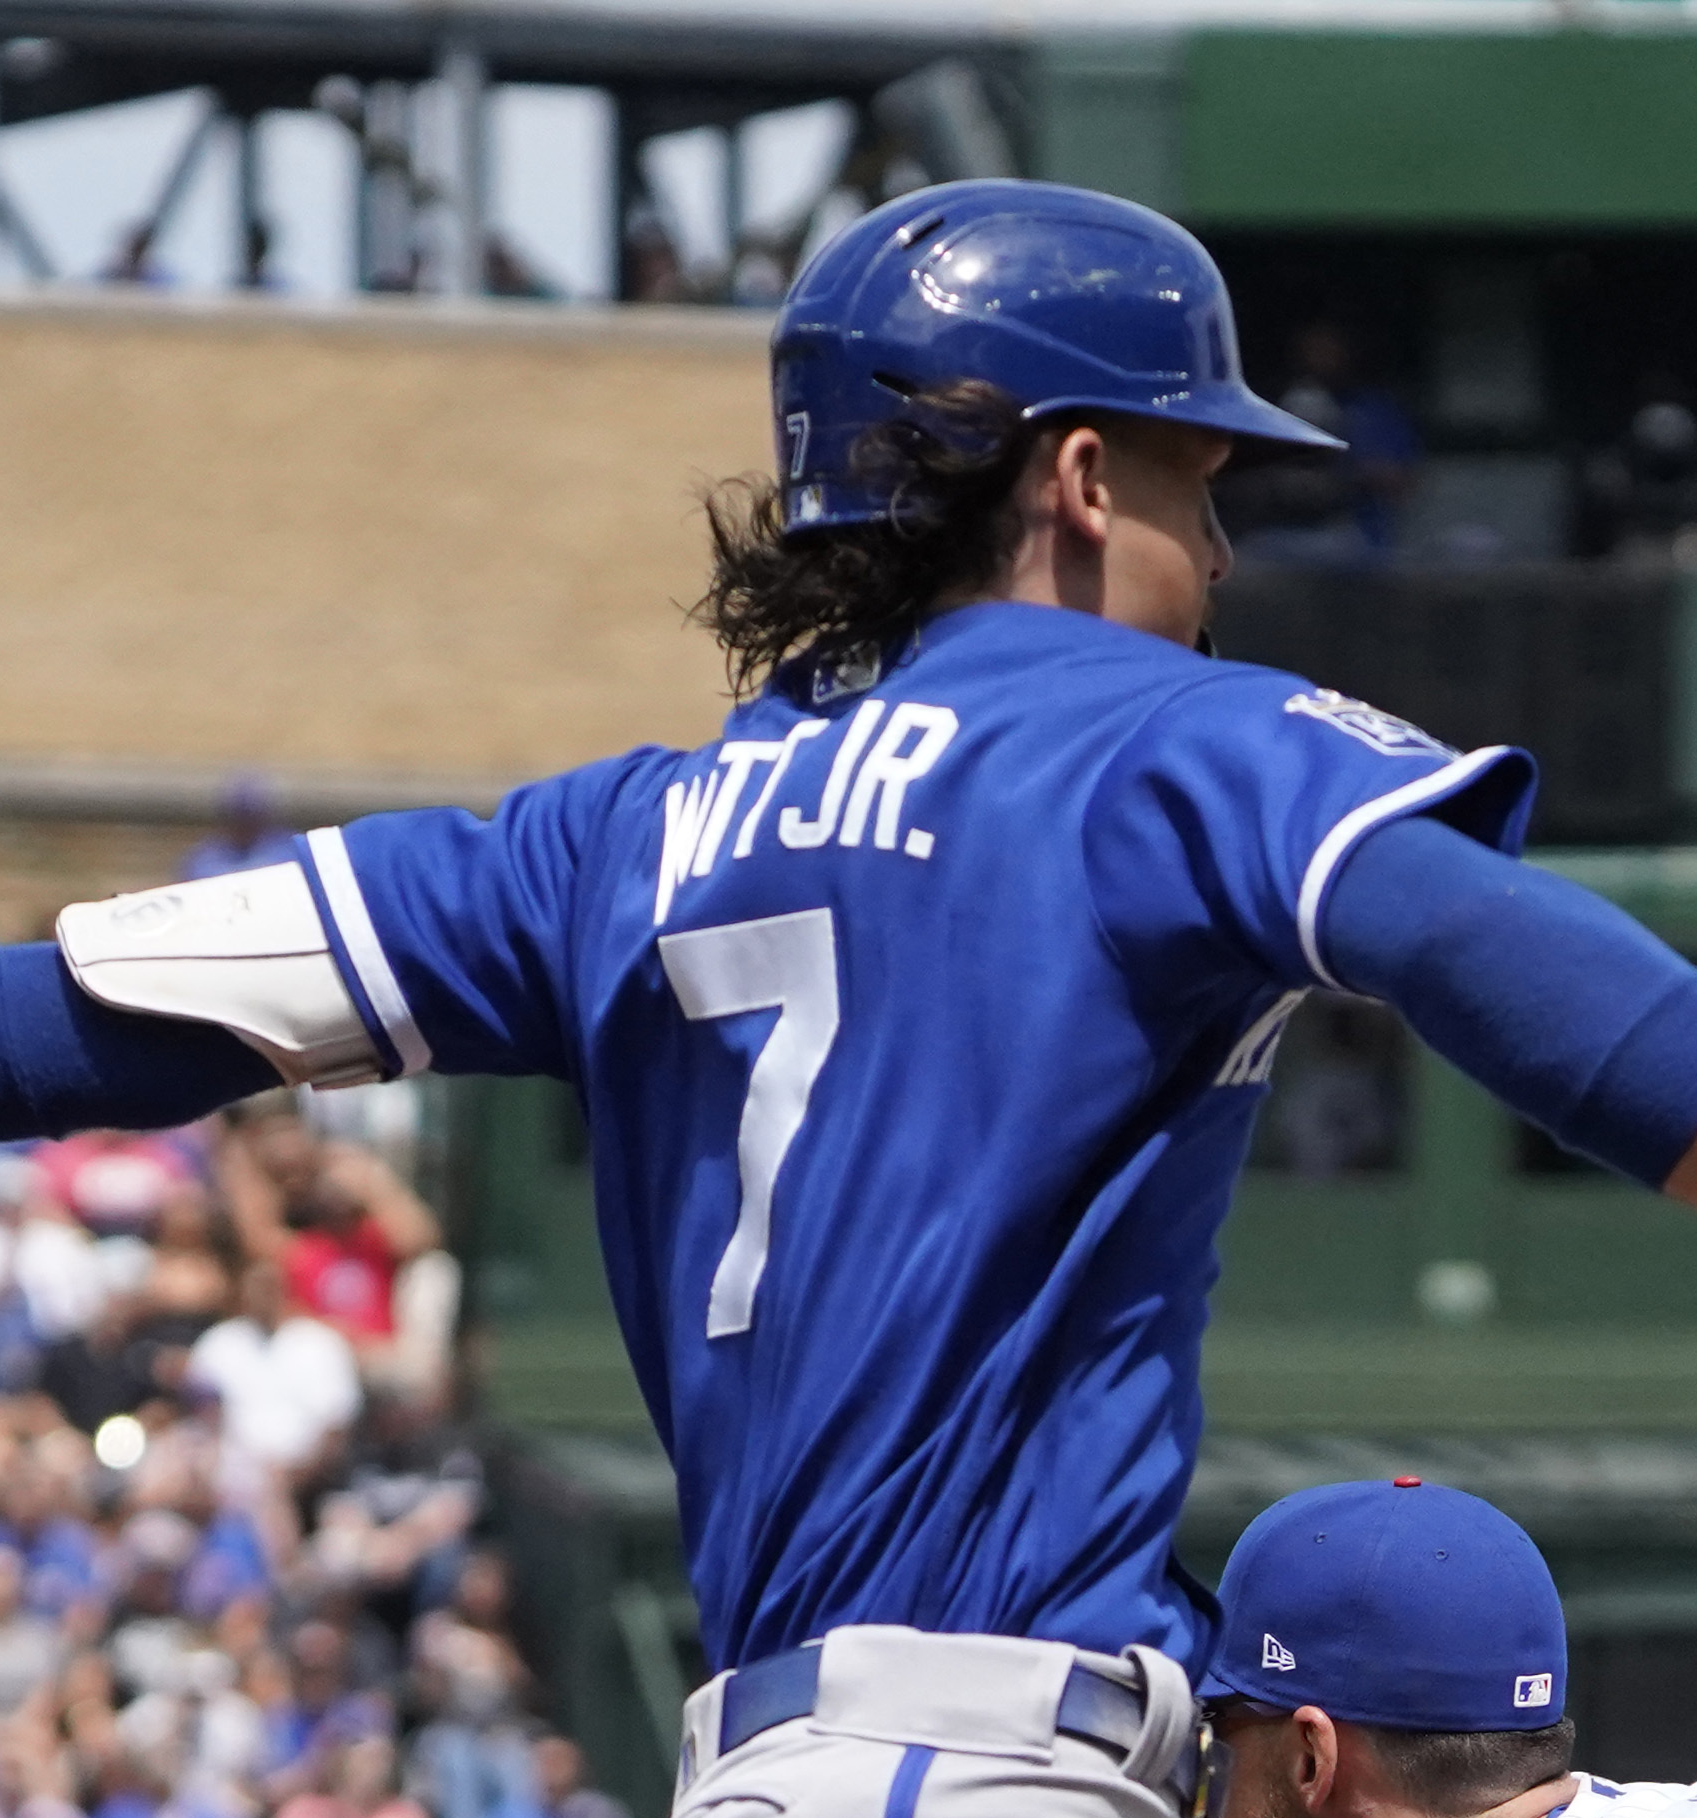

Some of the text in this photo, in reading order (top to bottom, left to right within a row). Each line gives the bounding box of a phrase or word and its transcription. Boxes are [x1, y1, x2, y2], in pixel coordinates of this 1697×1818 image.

[786, 411, 811, 480] 7
[654, 699, 960, 926] WTT JR.
[658, 907, 839, 1339] 7
